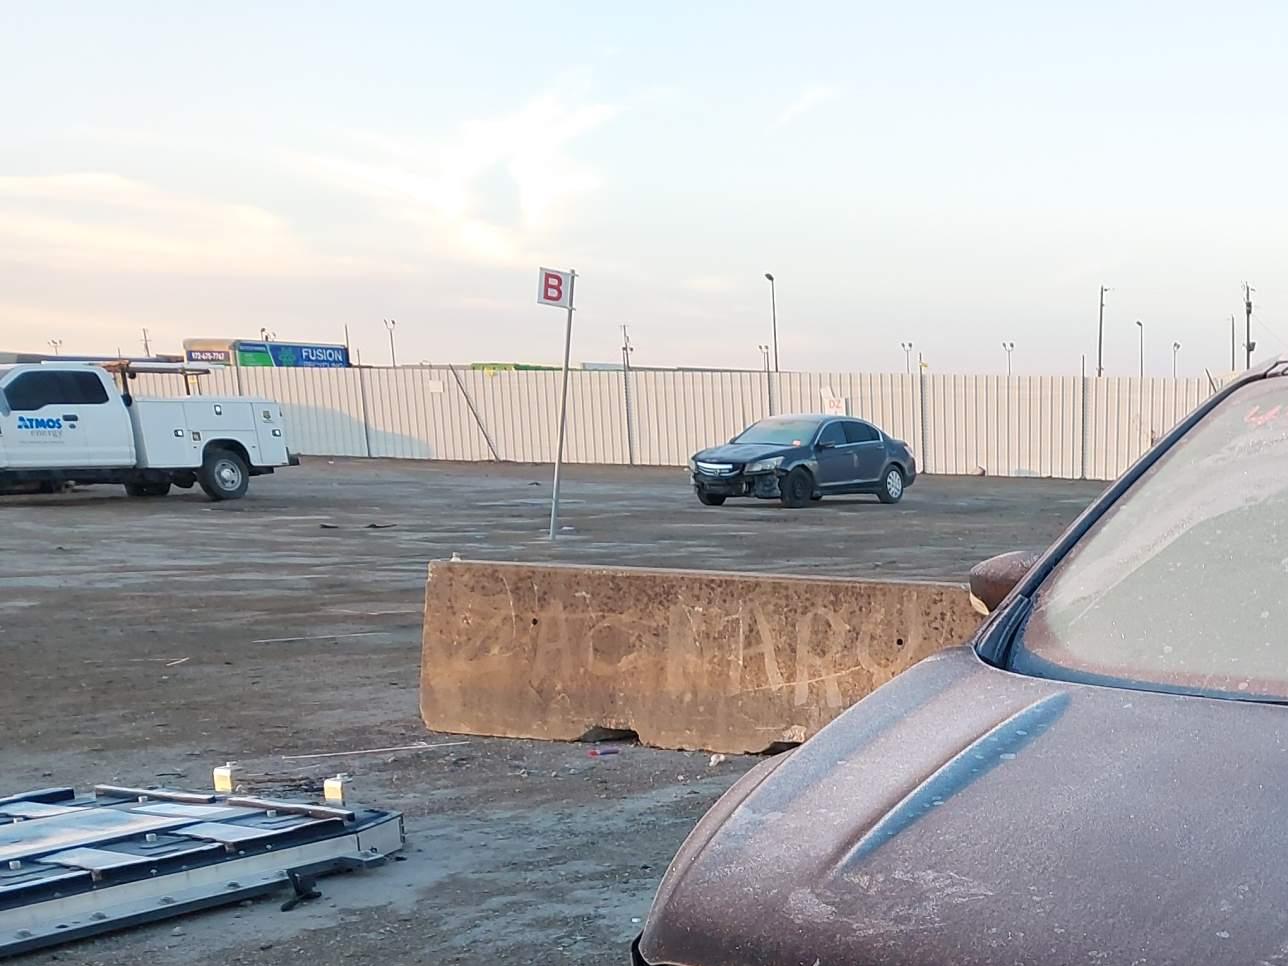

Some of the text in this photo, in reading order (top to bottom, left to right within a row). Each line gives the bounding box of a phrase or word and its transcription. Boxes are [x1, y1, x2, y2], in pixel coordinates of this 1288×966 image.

[543, 272, 563, 302] B
[302, 348, 343, 361] FUSION
[17, 415, 62, 429] ATMOS
